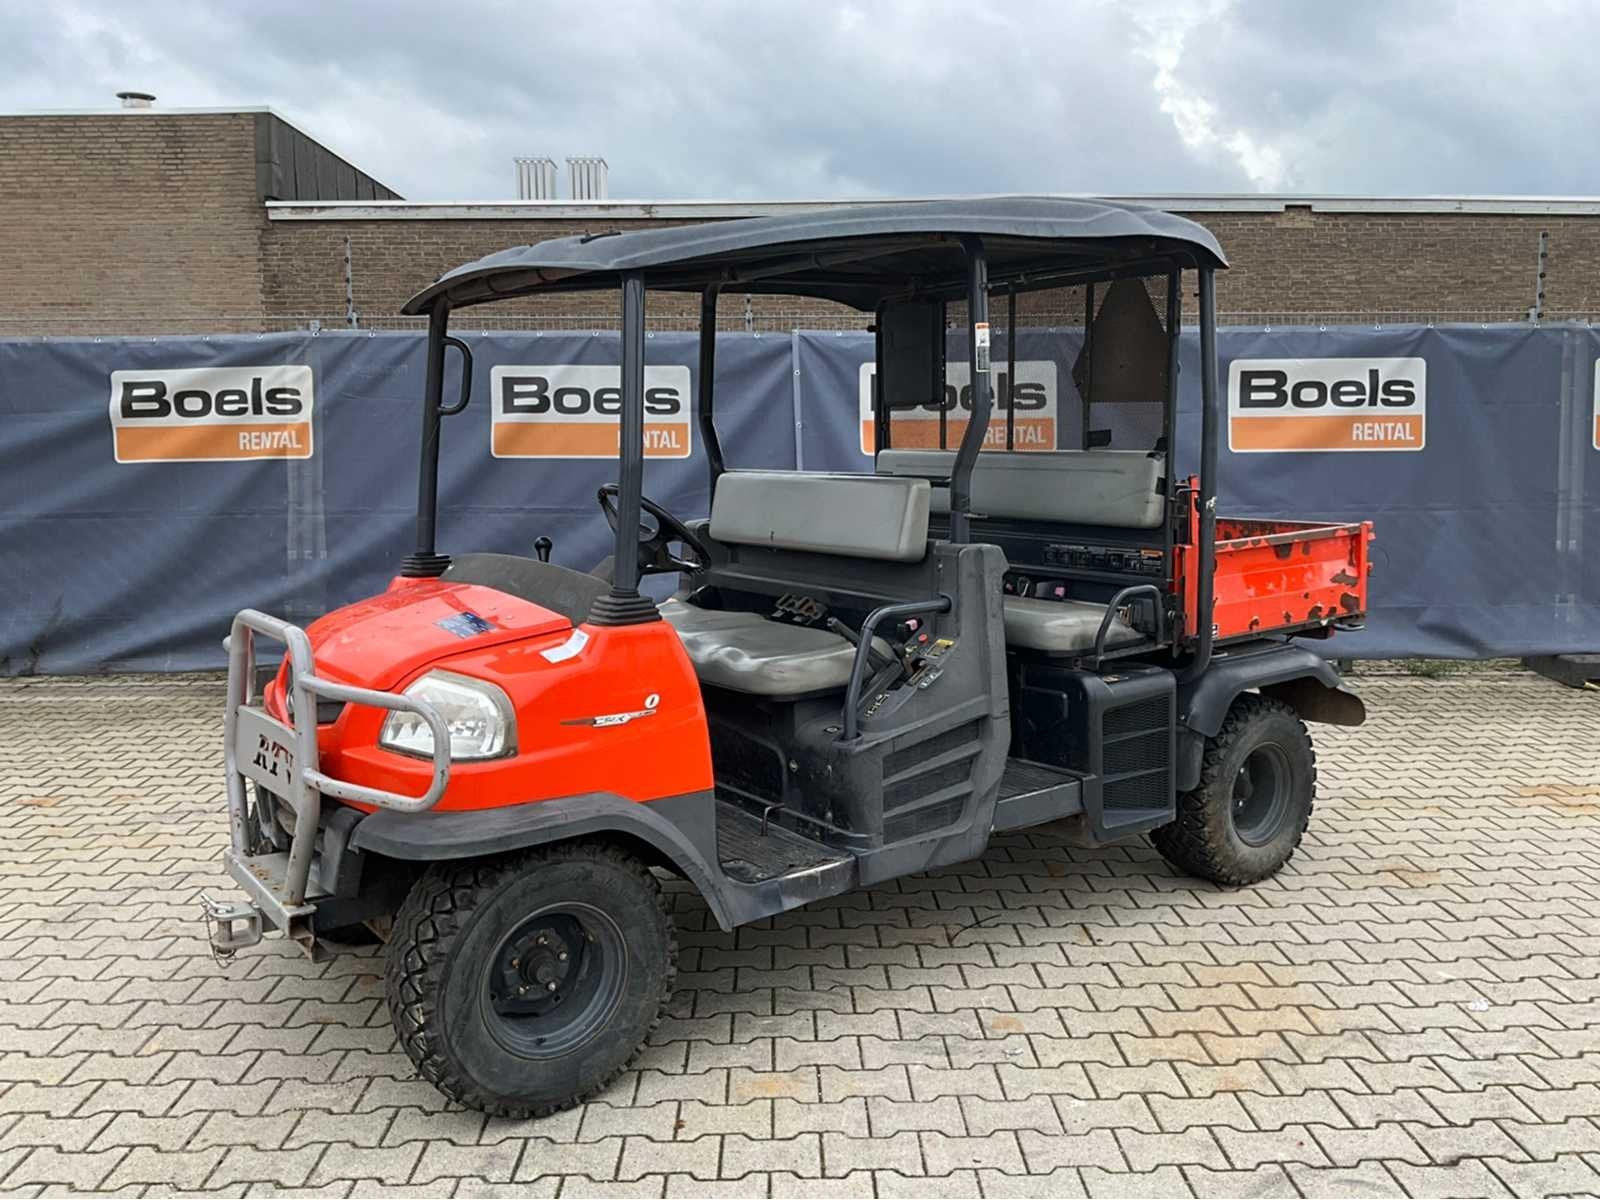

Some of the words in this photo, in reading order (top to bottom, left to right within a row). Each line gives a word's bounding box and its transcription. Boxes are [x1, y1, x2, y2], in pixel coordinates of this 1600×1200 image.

[121, 377, 303, 418] Boels
[501, 376, 681, 415] Boes
[1239, 368, 1416, 408] Boels
[239, 430, 303, 450] RENTAL
[617, 430, 681, 449] NTAL
[1352, 422, 1415, 441] RENTAL
